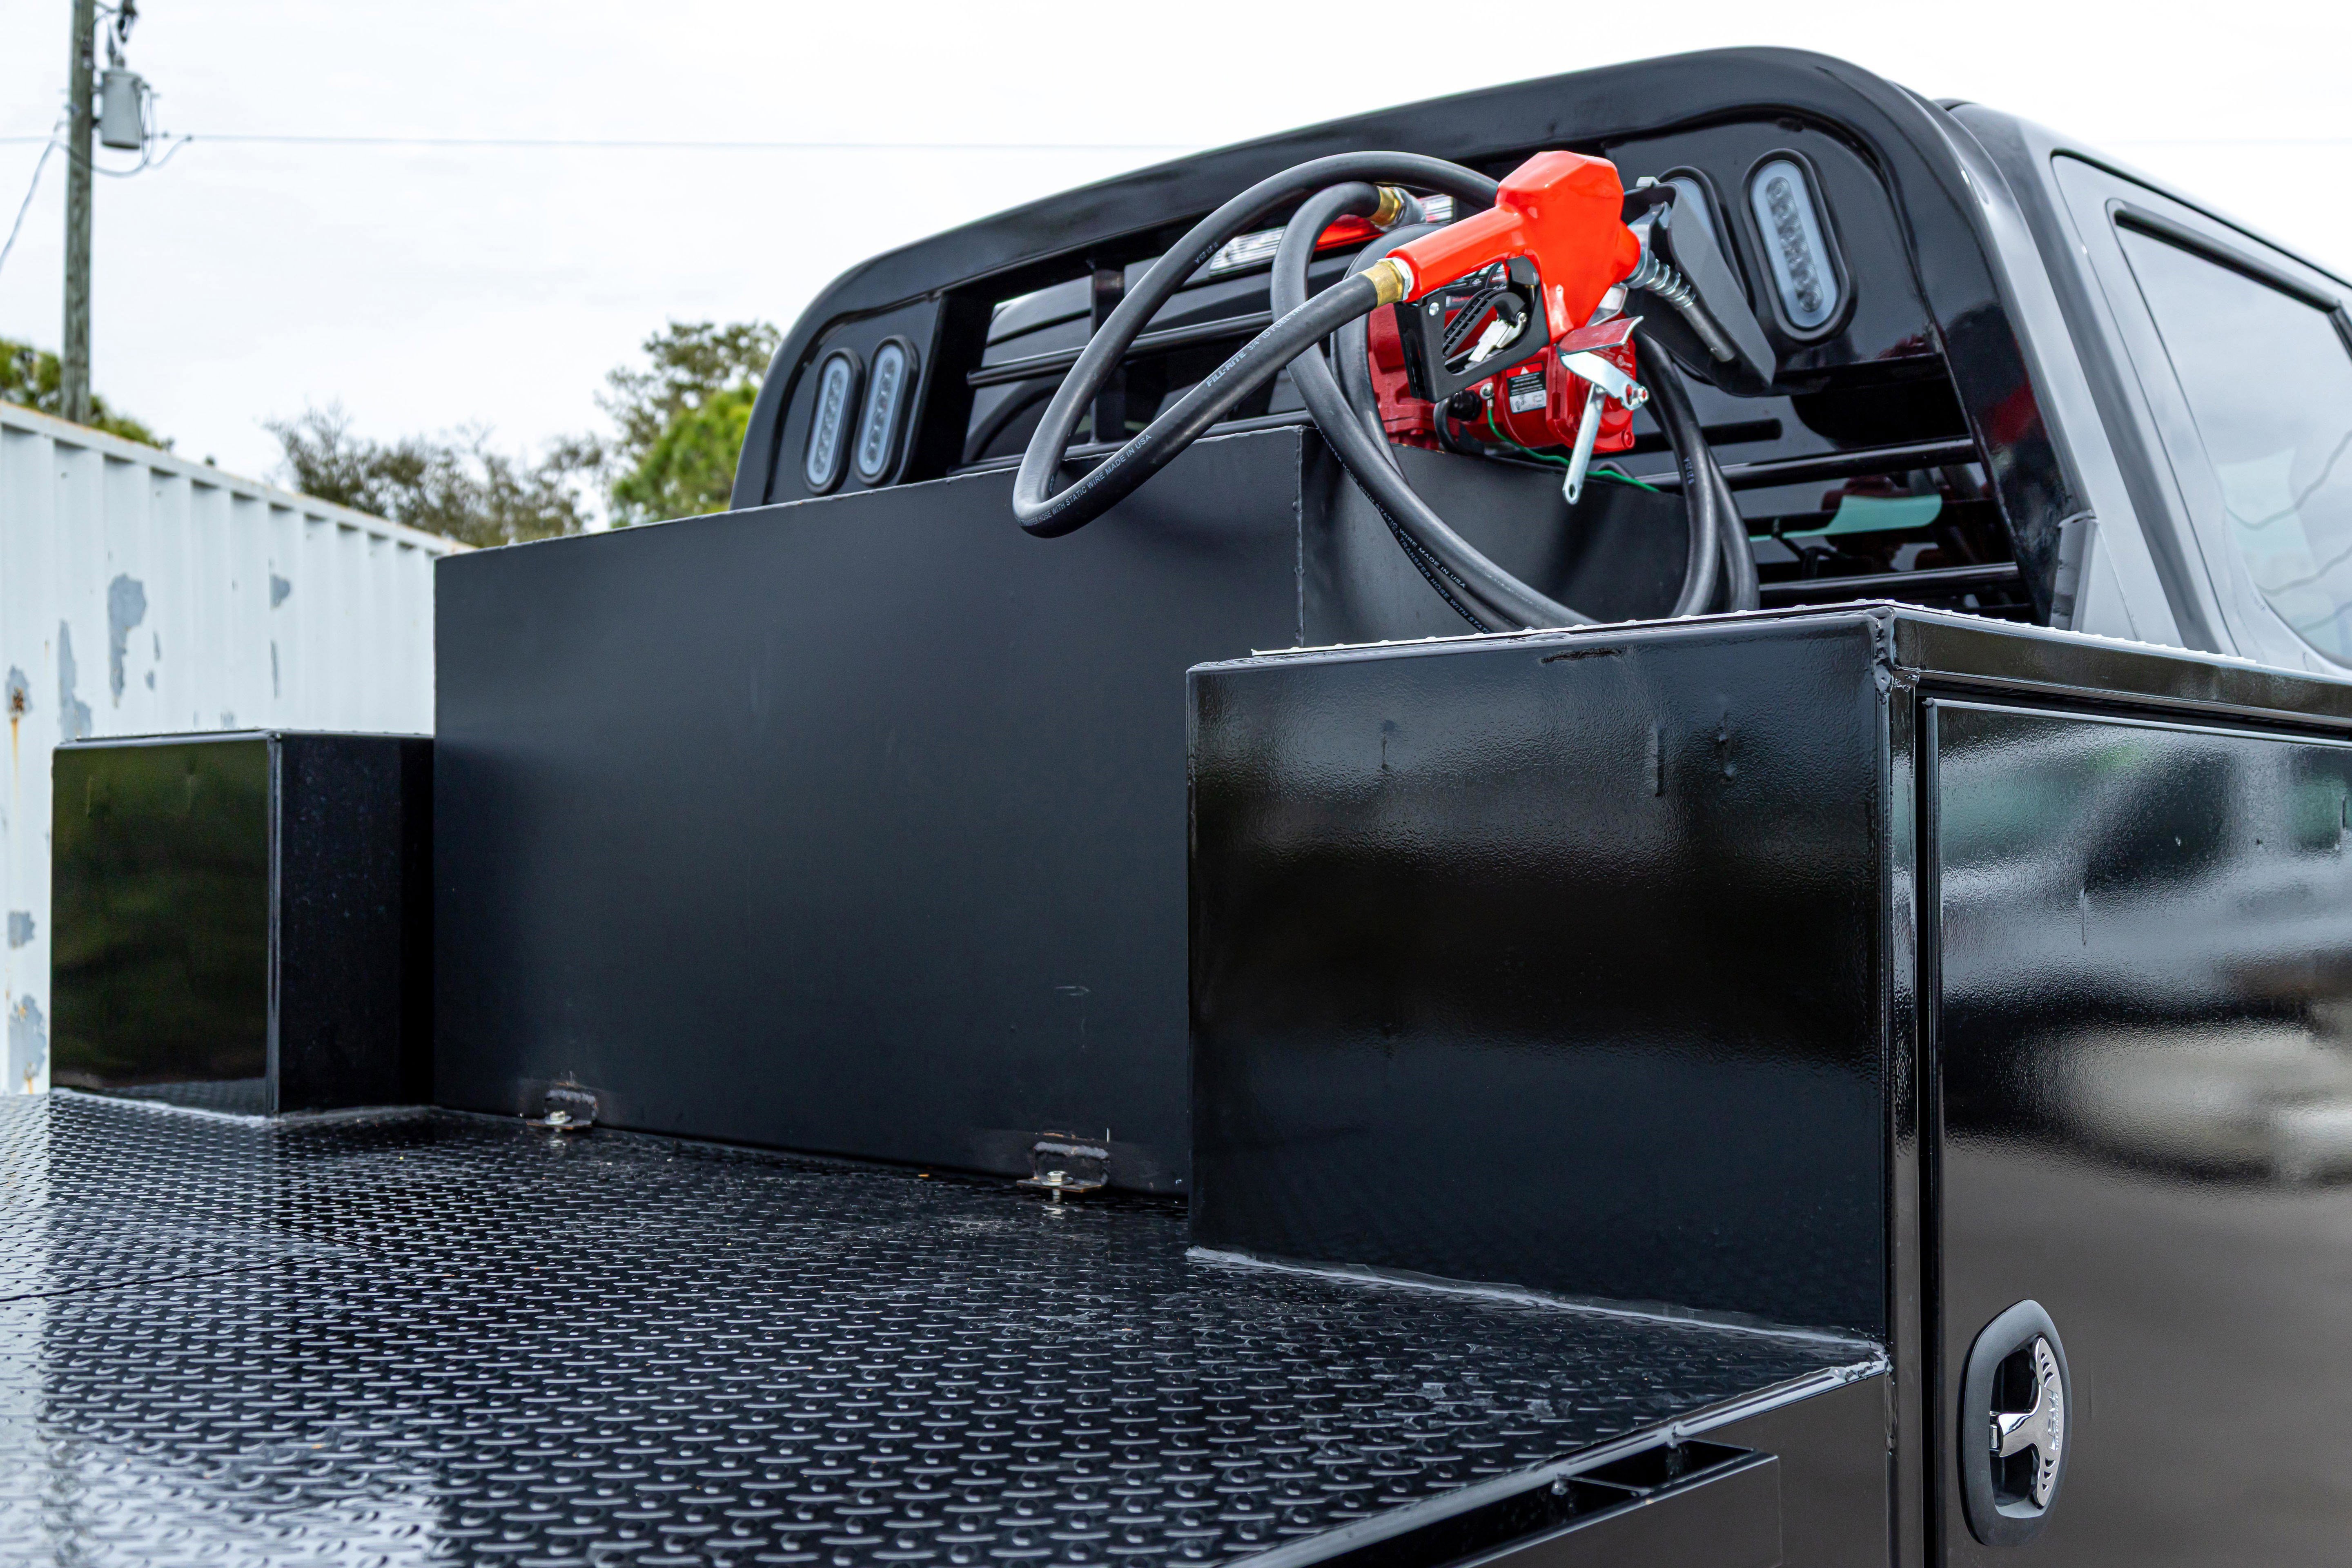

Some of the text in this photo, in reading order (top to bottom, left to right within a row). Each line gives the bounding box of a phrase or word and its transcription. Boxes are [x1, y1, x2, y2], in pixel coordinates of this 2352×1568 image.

[1247, 338, 1260, 350] 3/4"
[1270, 316, 1291, 332] FUEL
[1039, 510, 1052, 522] HOSE
[1051, 503, 1067, 515] WITH
[1066, 486, 1087, 506] STATIC
[1087, 472, 1105, 489] WIRE
[1105, 454, 1126, 475] MADE
[1126, 448, 1135, 457] IN
[1135, 434, 1152, 449] USA
[1399, 528, 1417, 548] WIRE
[1418, 548, 1440, 567] MADE
[1450, 575, 1466, 589] USA
[1399, 537, 1430, 578] TRANSFER
[1430, 578, 1450, 599] HOSE
[1450, 599, 1468, 617] WITH
[1468, 617, 1490, 633] STATI
